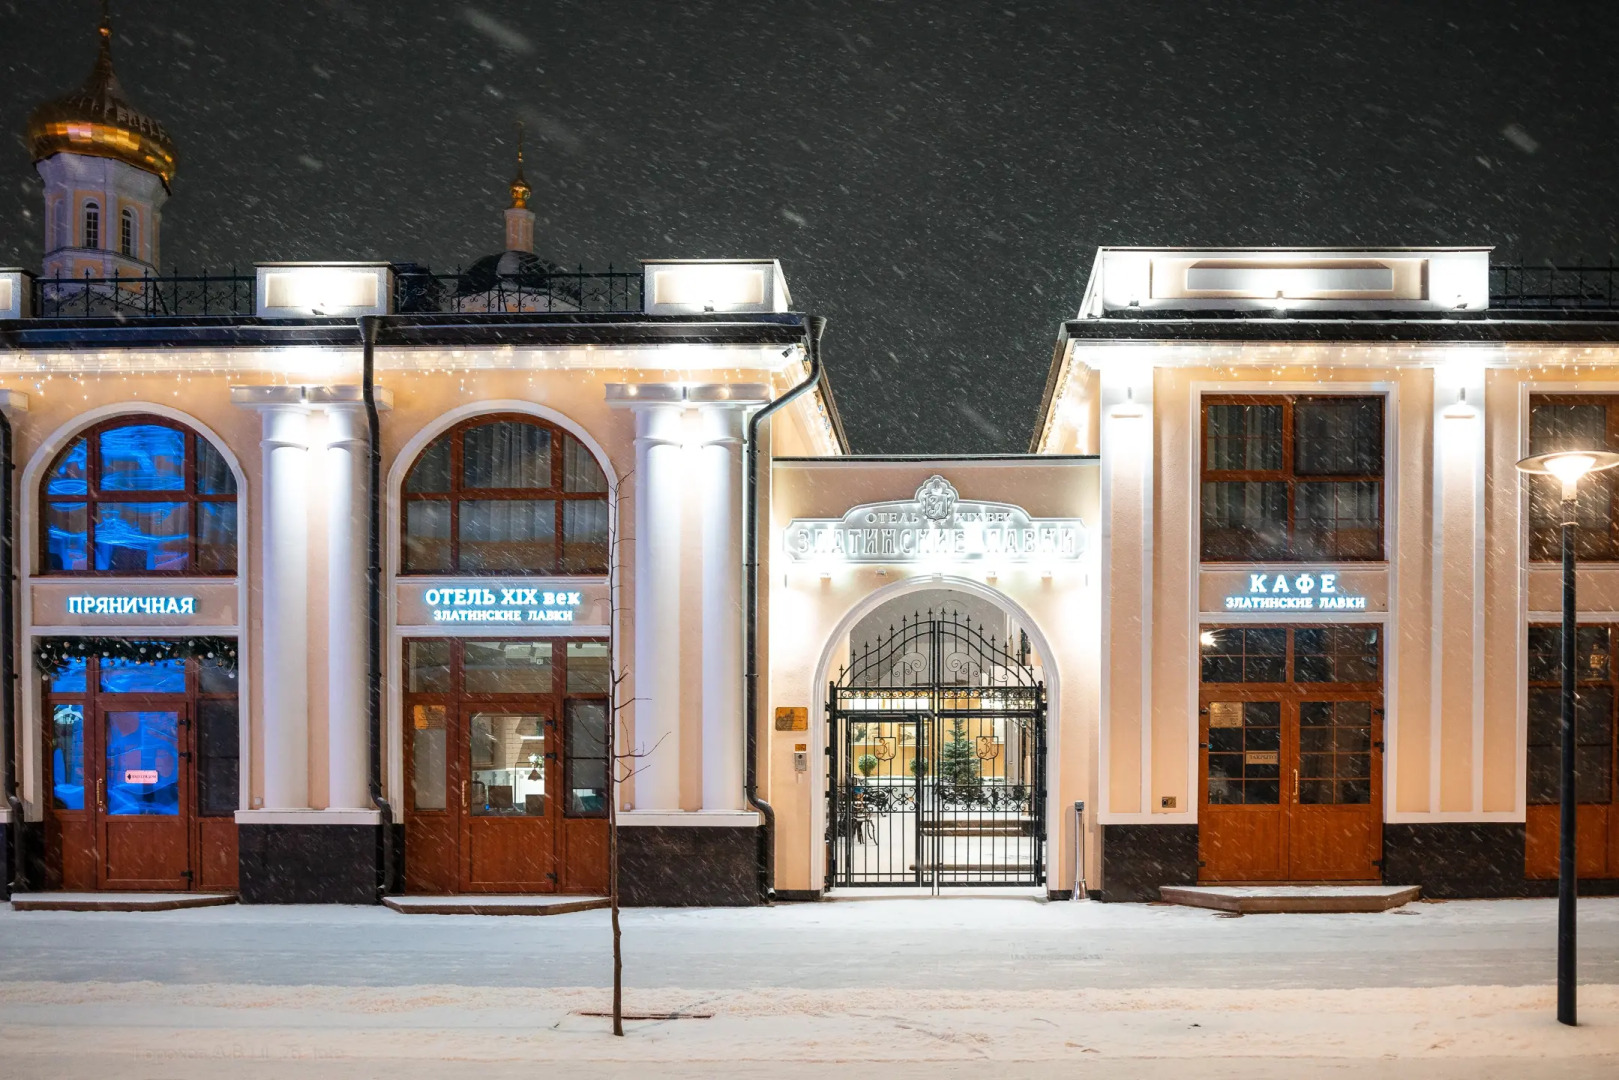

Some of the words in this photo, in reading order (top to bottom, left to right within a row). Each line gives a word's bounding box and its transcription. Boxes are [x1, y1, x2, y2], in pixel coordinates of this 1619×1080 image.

[864, 512, 920, 524] ОТЕЛЬ
[1249, 573, 1336, 594] КАФЕ
[425, 588, 497, 606] ОТЕЛЬ
[542, 591, 581, 605] век
[1225, 597, 1314, 609] ЗЛАТИНСКИЕ
[1318, 597, 1366, 609] ЛАВКИ
[68, 596, 194, 614] ПРЯНИЧНАЯ
[433, 609, 522, 621] ЗЛАТИНСКИЕ
[527, 610, 573, 621] ЛАВКИ
